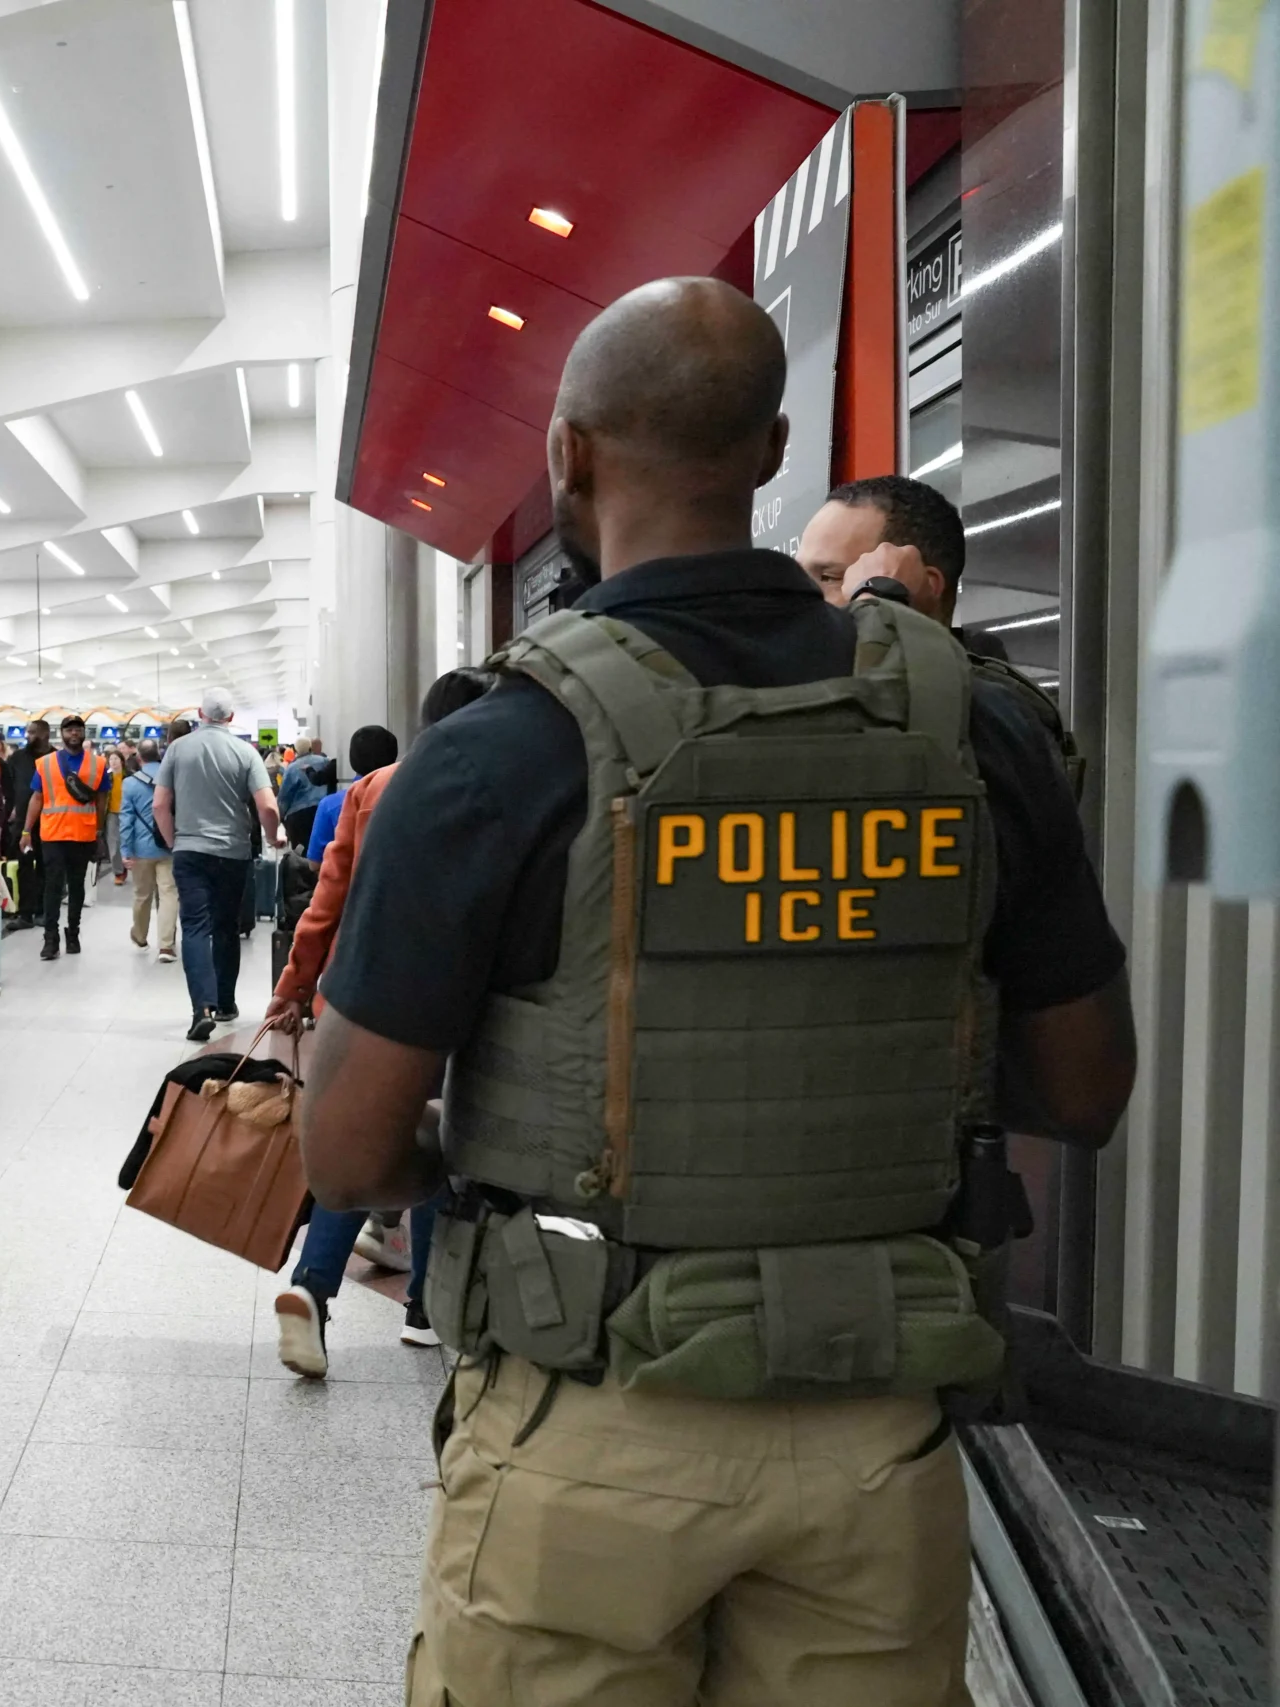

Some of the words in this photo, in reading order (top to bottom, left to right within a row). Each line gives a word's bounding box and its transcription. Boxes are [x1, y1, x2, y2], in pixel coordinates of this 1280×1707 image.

[924, 298, 943, 325] Sur
[767, 496, 782, 530] UP
[656, 807, 963, 885] POLICE
[743, 889, 876, 943] ICE
